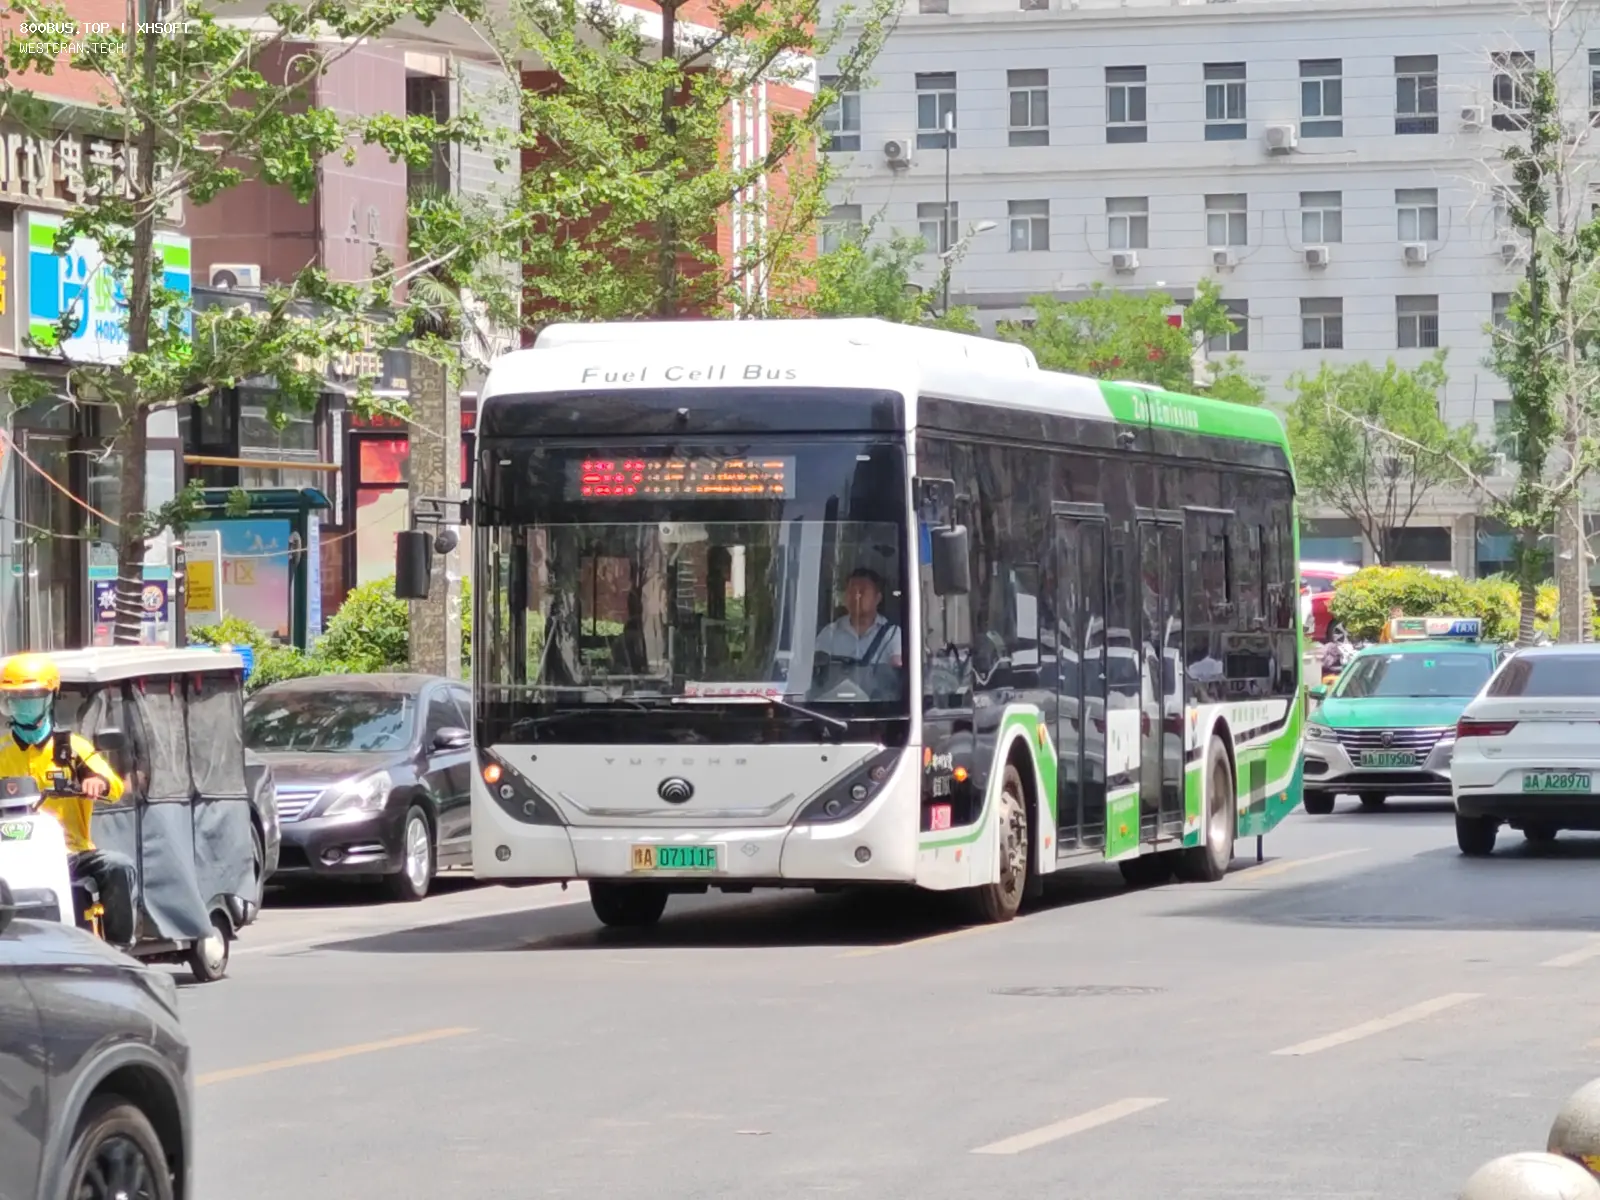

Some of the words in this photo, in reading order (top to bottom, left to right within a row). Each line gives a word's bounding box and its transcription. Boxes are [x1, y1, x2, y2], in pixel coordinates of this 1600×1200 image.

[580, 366, 648, 384] Fuel
[664, 365, 726, 382] Cell
[742, 364, 798, 381] Bus
[1455, 622, 1478, 634] TAXI
